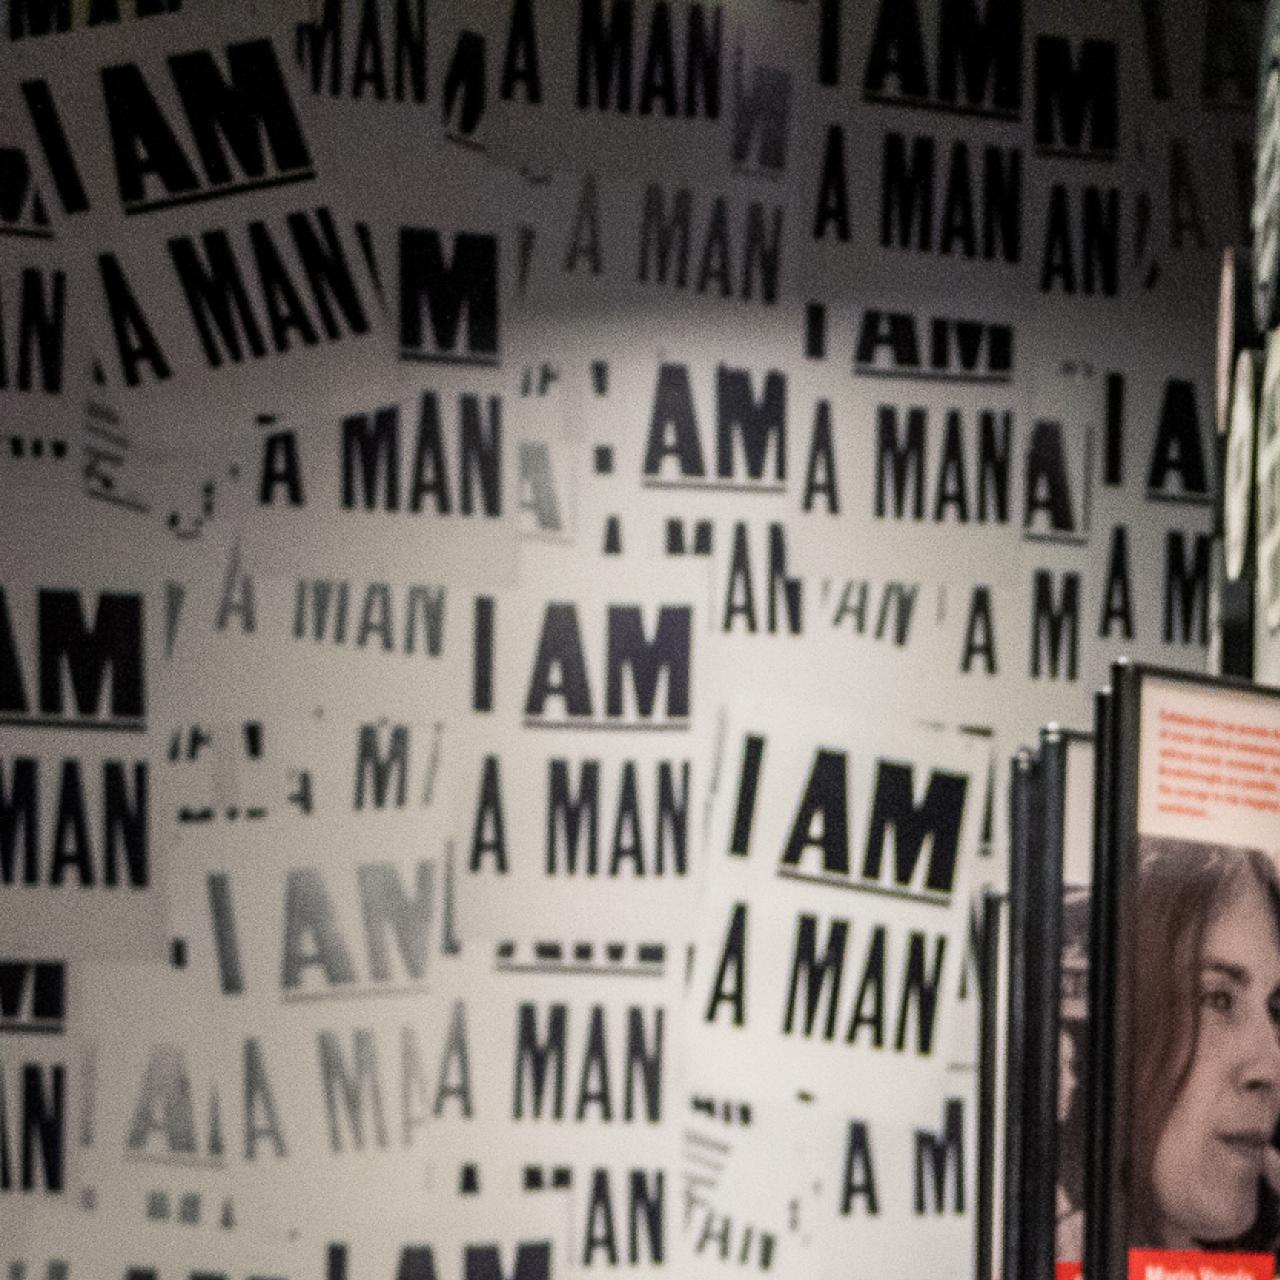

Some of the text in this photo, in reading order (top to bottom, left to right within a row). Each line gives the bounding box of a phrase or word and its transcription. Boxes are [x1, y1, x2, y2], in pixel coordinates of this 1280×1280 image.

[21, 37, 315, 213] I AM
[812, 125, 1022, 264] A MAN
[98, 205, 371, 387] A MAN
[643, 361, 787, 480] AM
[802, 402, 1011, 524] A MAN
[473, 595, 692, 717] I AM
[469, 753, 690, 877] A MAN
[729, 734, 969, 894] I AM
[704, 902, 946, 1056] A MAN
[514, 1002, 664, 1124] MAN
